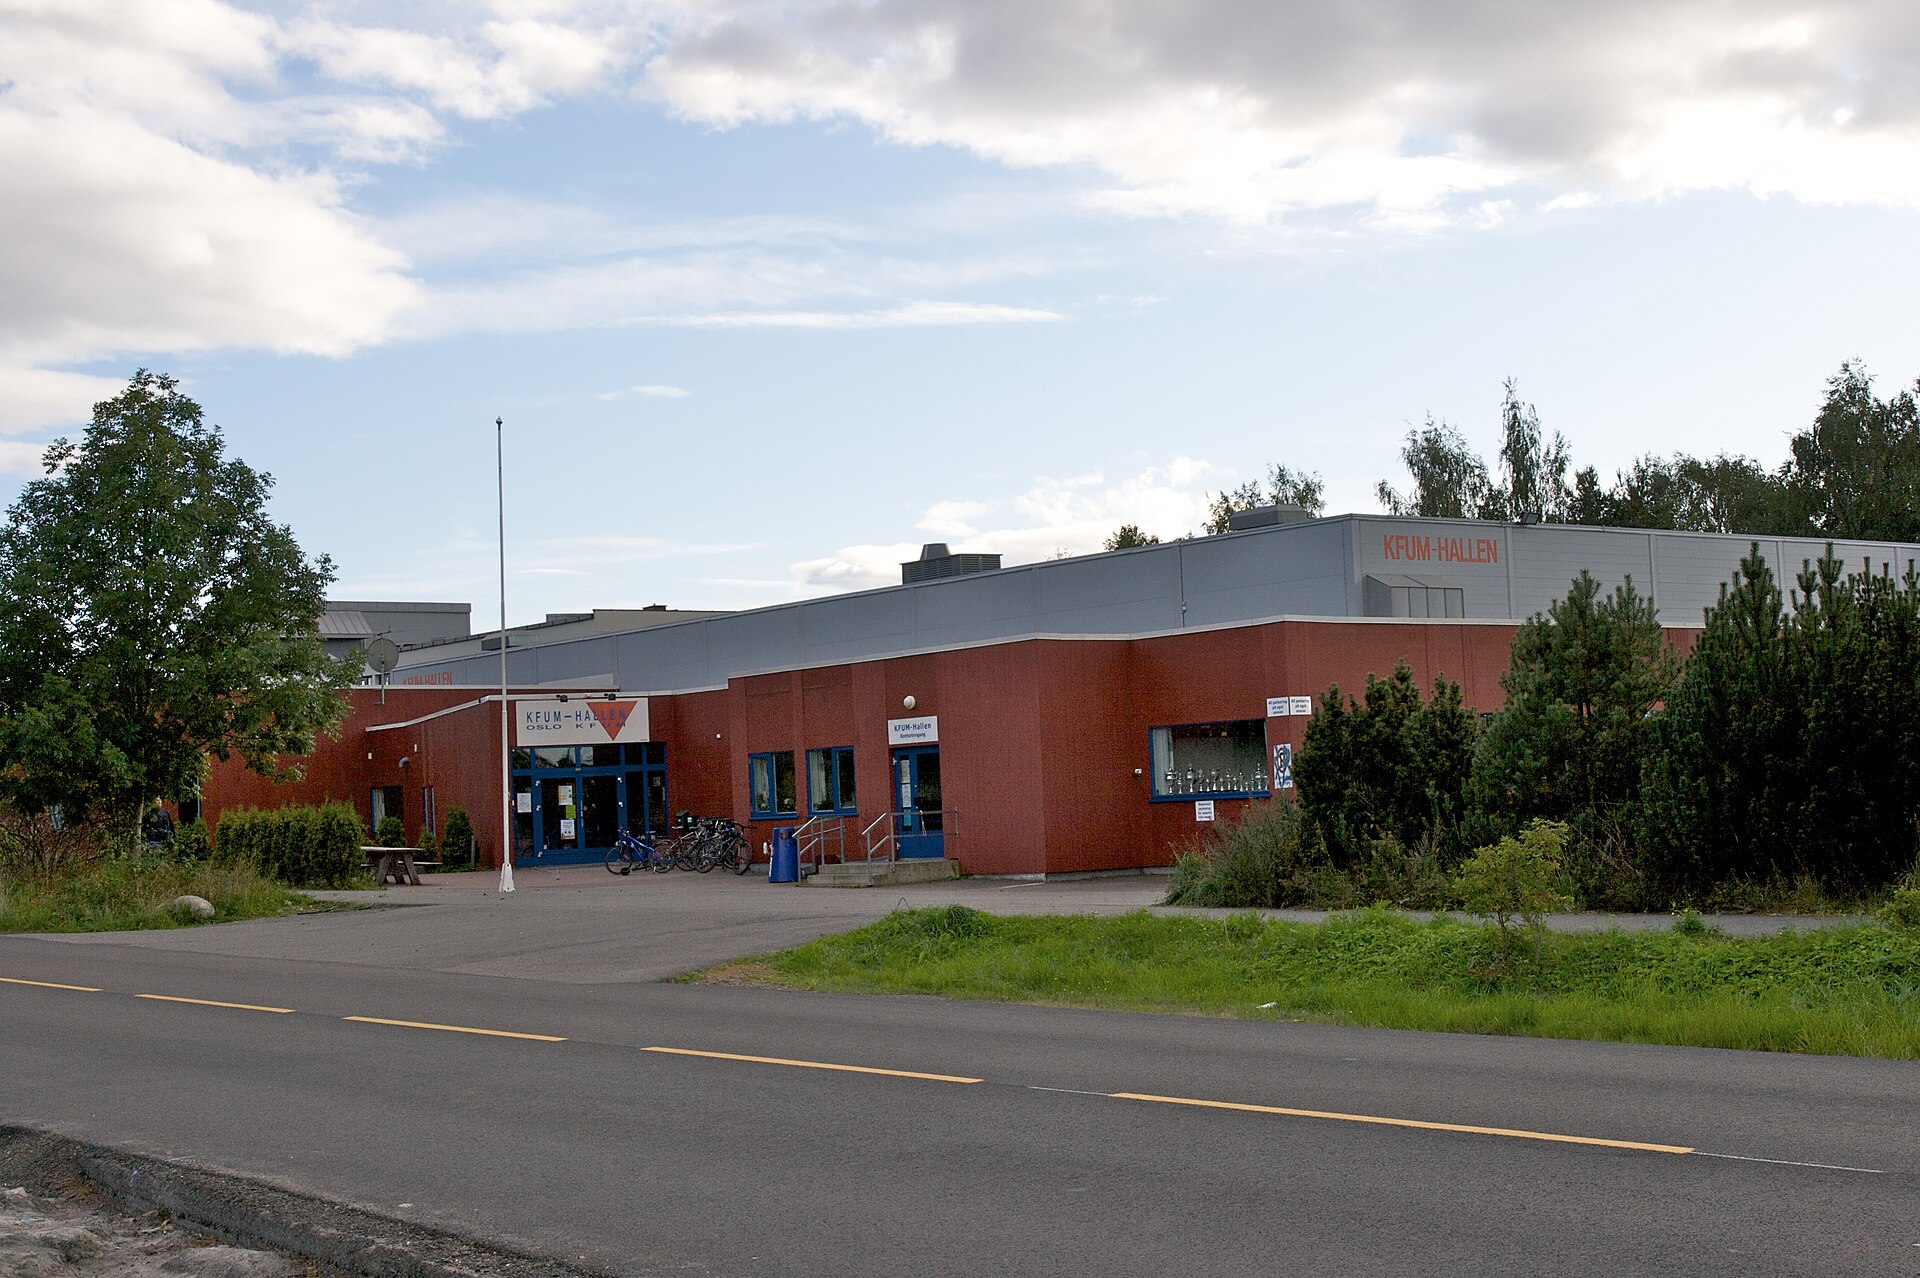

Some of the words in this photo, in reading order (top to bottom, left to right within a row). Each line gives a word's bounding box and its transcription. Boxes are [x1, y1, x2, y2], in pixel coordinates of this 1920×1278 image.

[1383, 535, 1498, 563] KFUM-HALLEN
[526, 709, 626, 723] KFUM-HALLEN
[526, 723, 562, 731] OSLO
[894, 722, 932, 731] KFUM-Hallen
